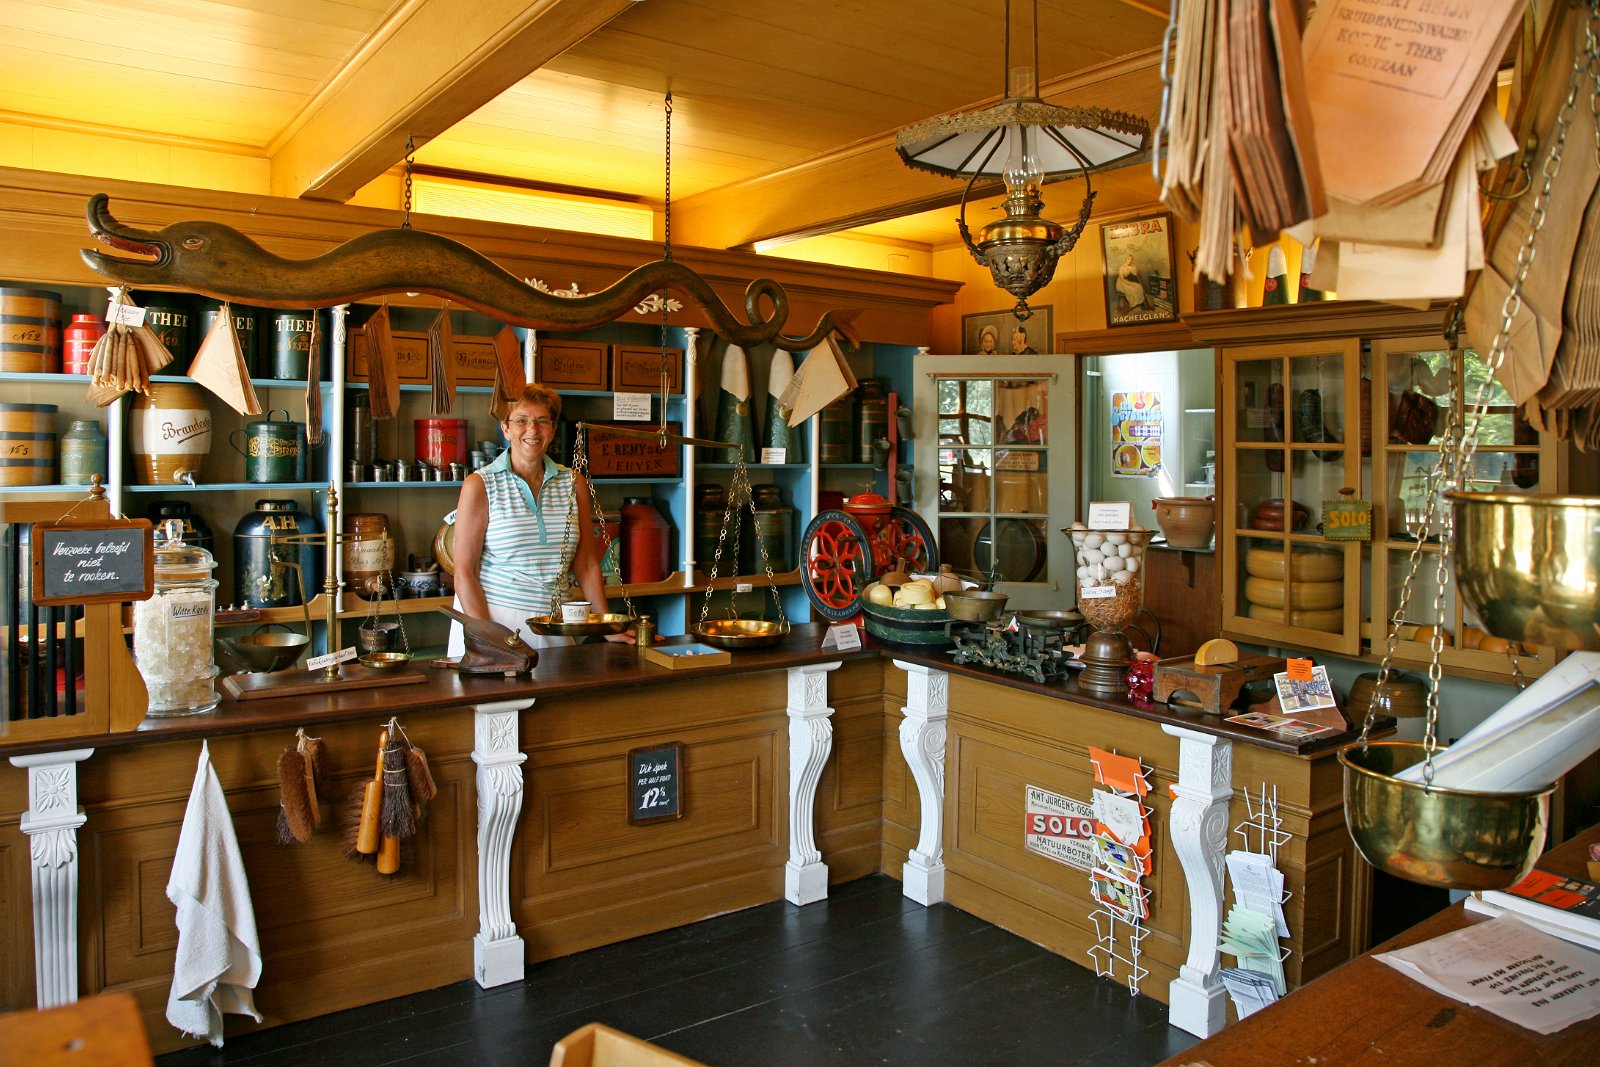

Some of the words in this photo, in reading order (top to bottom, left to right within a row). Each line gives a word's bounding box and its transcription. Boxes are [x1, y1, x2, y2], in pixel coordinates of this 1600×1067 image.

[1406, 42, 1446, 62] THEE
[1349, 54, 1417, 77] OOSTZAAN
[1109, 219, 1162, 240] ZEBRA
[150, 311, 188, 328] THEE
[211, 315, 253, 331] TEE
[1113, 311, 1170, 323] KACHELGLANS
[275, 319, 314, 333] THEE
[614, 443, 646, 457] REMY
[607, 459, 663, 473] LEUVEN
[1327, 511, 1367, 528] SOLO
[53, 541, 94, 557] Verzoeke
[95, 541, 131, 555] beleefd
[77, 555, 103, 568] niet
[63, 570, 75, 583] te
[78, 569, 120, 583] rooken.
[173, 605, 191, 617] Witte
[639, 762, 652, 775] Dik
[652, 760, 668, 773] spek
[638, 777, 647, 786] PER
[1033, 815, 1094, 838] SOLO
[1518, 986, 1543, 996] TOUCH
